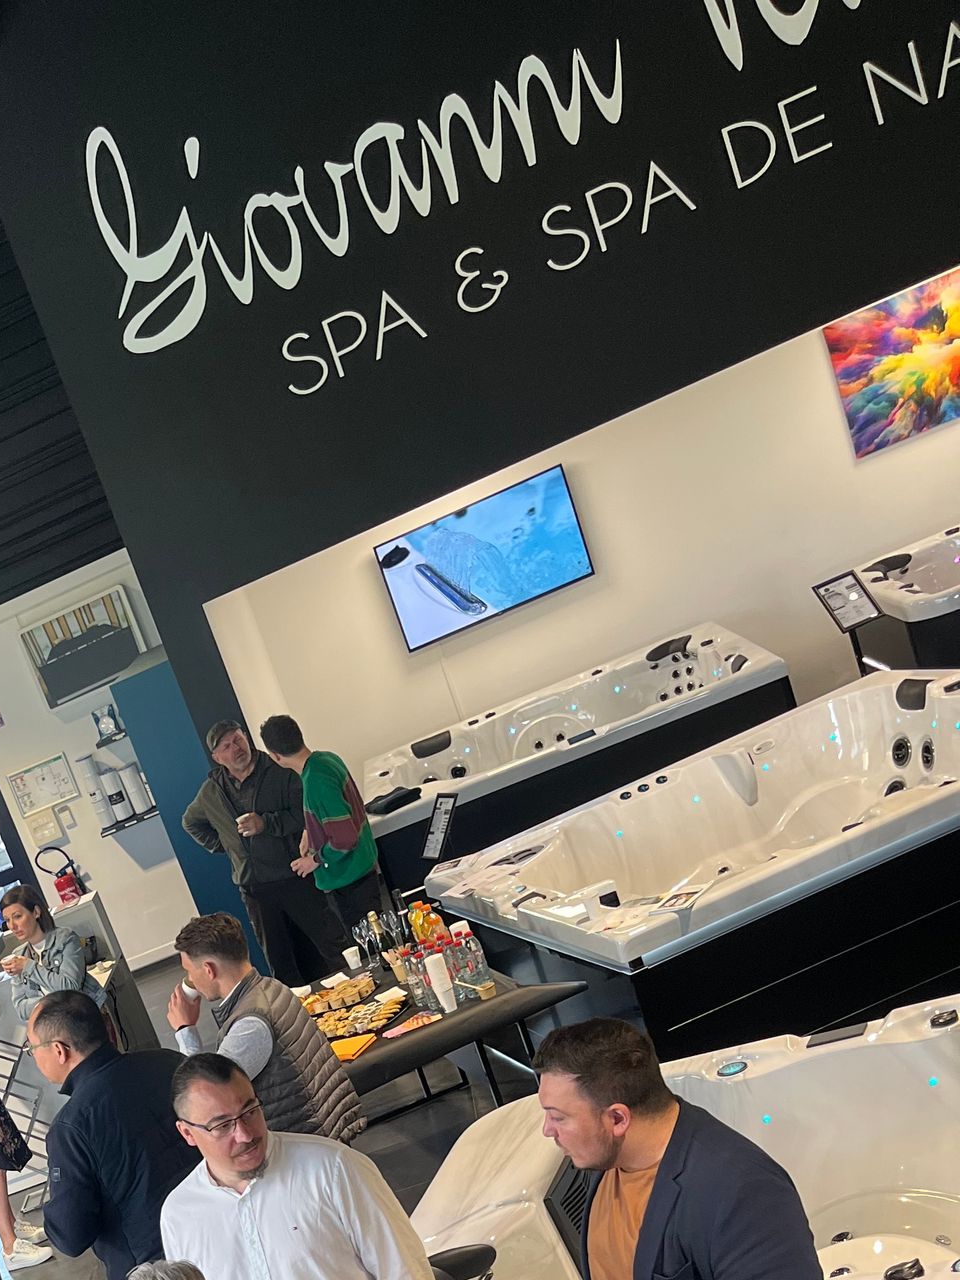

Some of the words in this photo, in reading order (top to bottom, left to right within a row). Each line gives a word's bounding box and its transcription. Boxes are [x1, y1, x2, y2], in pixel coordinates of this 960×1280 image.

[282, 291, 428, 395] SPA
[455, 247, 509, 313] &
[542, 160, 697, 271] SPA
[721, 86, 833, 189] DE
